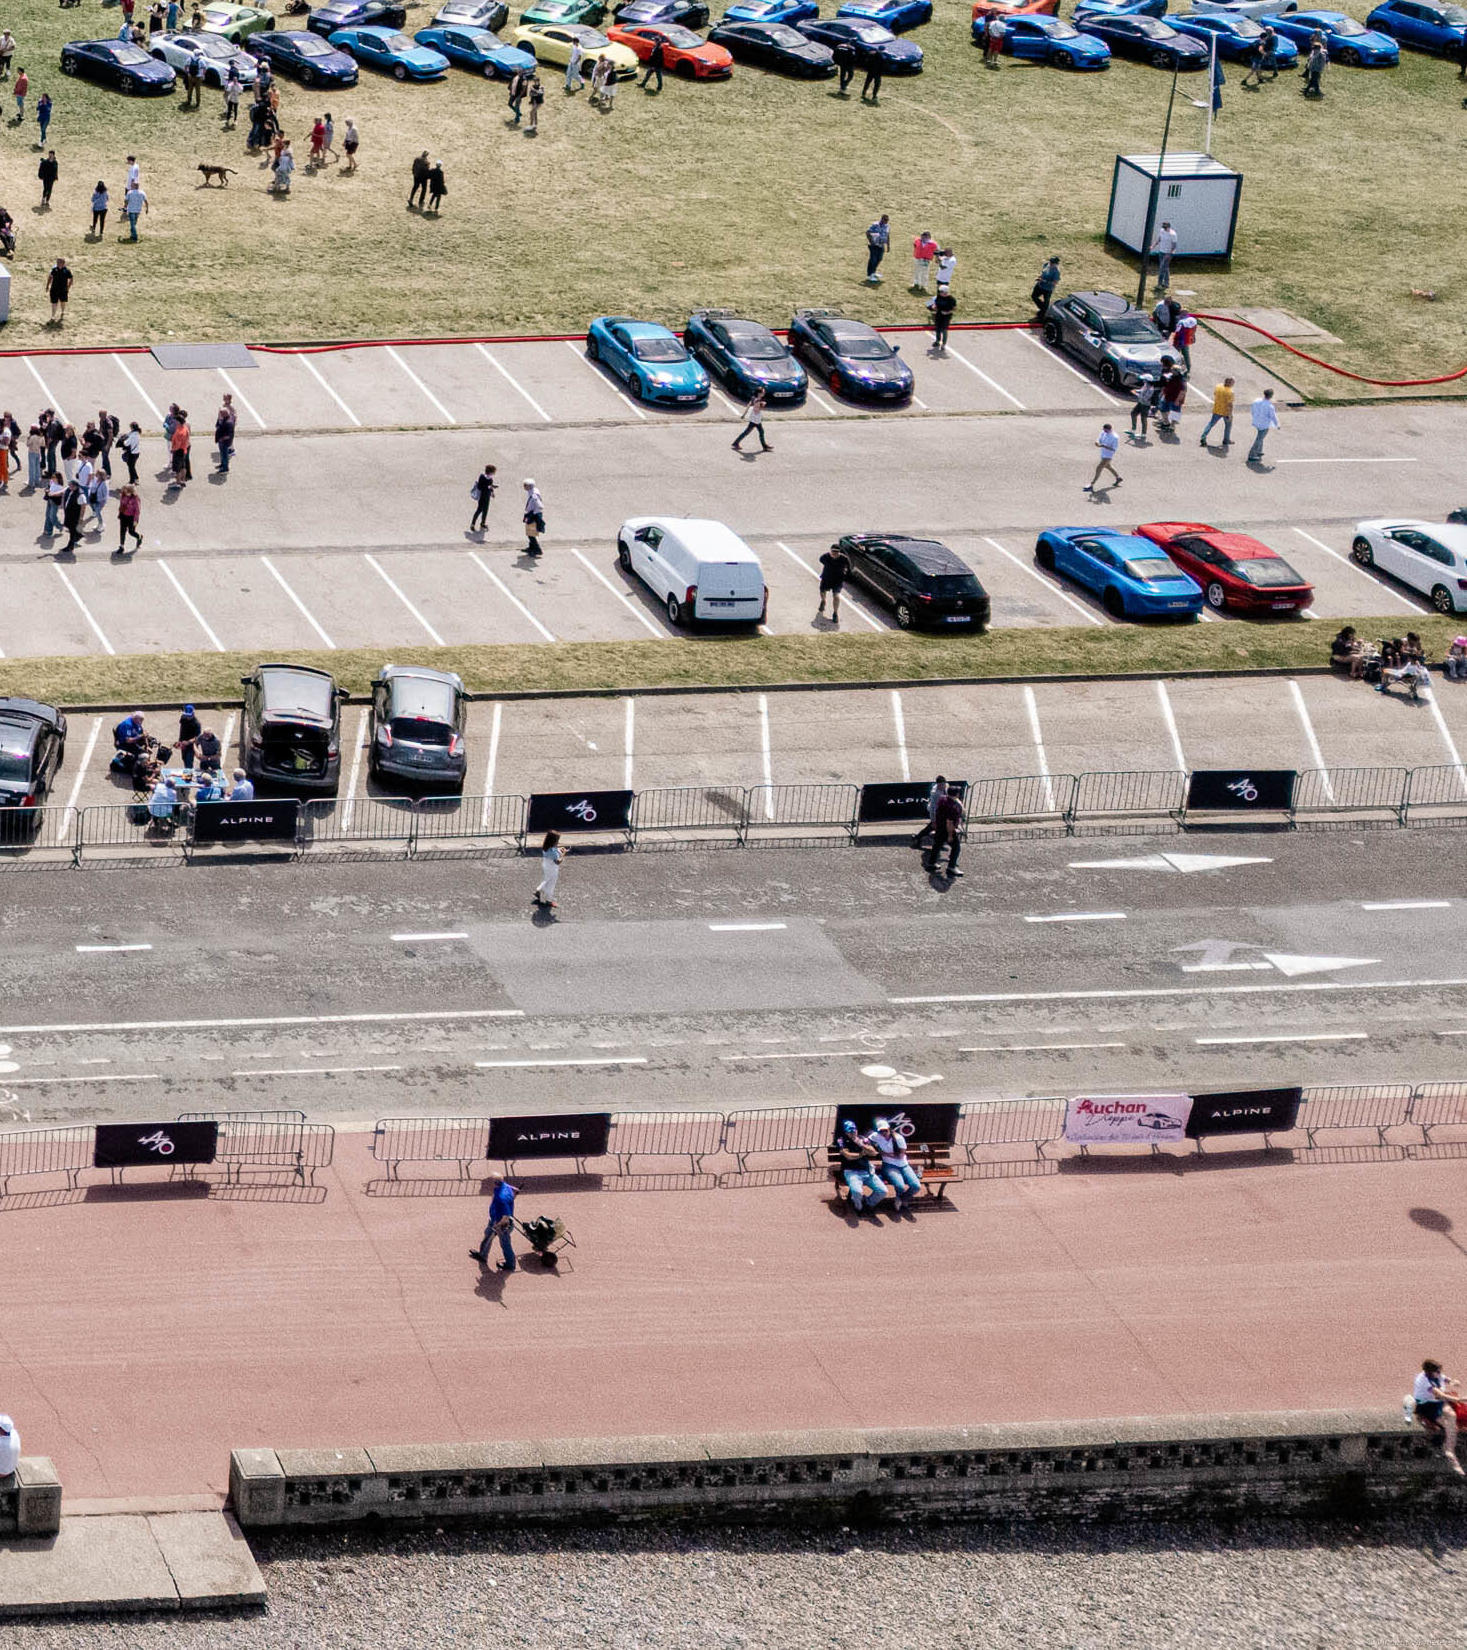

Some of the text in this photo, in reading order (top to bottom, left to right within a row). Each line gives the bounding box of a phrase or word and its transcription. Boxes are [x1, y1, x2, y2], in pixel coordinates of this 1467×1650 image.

[887, 797, 930, 805] ALPIN
[220, 816, 273, 824] ALPINE
[1076, 1099, 1147, 1115] Auchan
[1211, 1107, 1271, 1118] ALPINE
[518, 1131, 581, 1141] ALPINE
